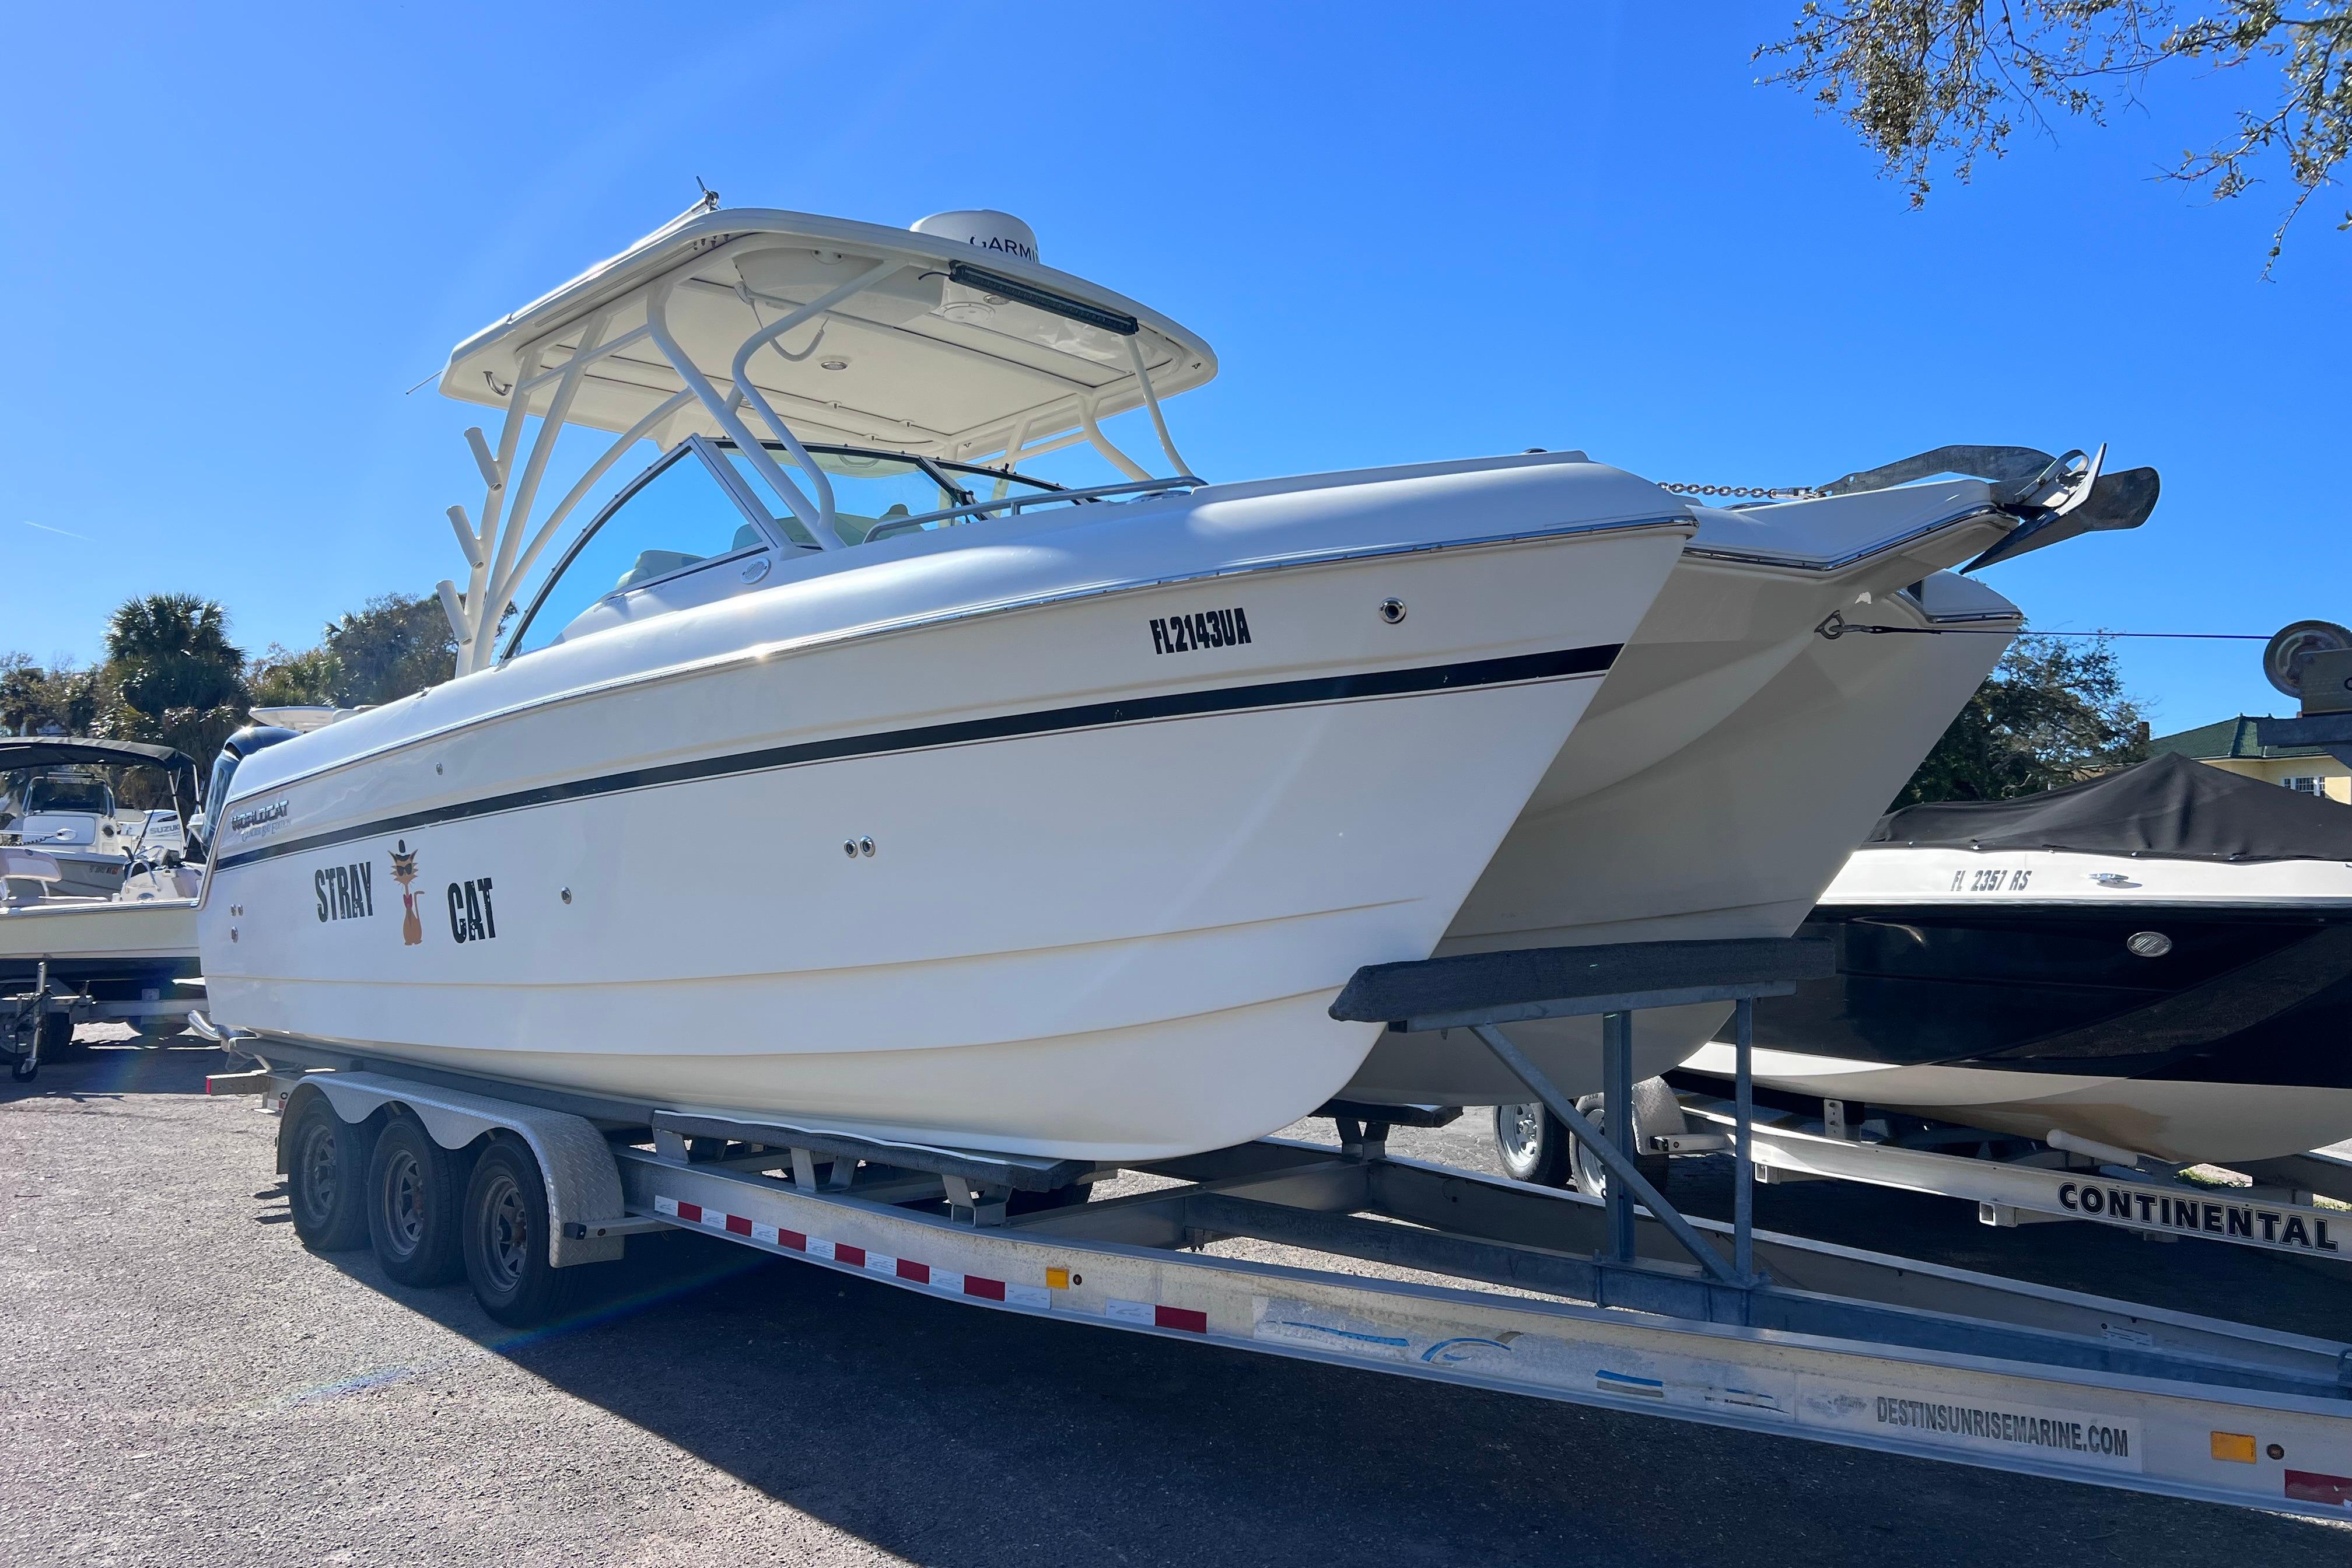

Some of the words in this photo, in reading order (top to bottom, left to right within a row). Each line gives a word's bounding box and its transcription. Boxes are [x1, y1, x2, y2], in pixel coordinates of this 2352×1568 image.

[1149, 607, 1252, 654] FL2143UA
[314, 862, 373, 923] STRAY
[447, 877, 496, 944] CAT
[1950, 870, 1966, 891] FL
[1970, 870, 2008, 891] 2357
[2008, 870, 2032, 891] RS
[2058, 1182, 2338, 1252] CONTINENTAL
[1877, 1396, 2129, 1457] DESTINSUNRISEMARINE.COM
